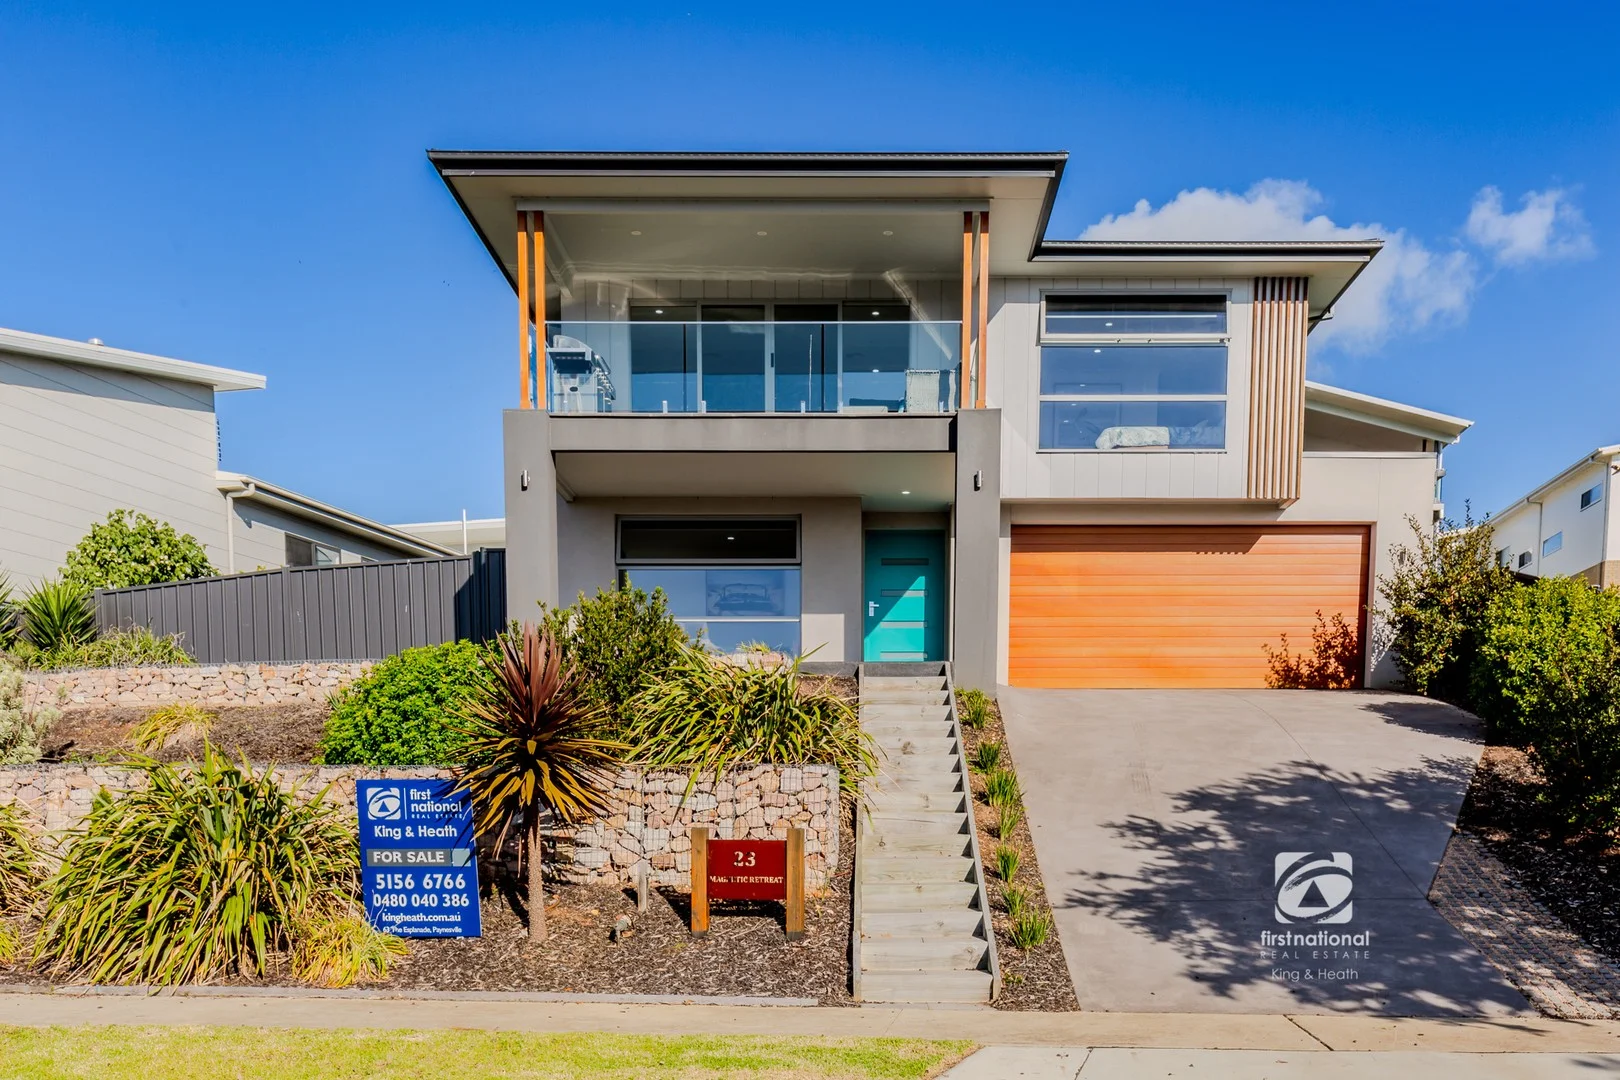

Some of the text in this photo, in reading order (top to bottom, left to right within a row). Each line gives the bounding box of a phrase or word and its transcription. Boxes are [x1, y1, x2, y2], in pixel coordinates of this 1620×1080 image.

[410, 788, 431, 801] first
[411, 801, 462, 813] national
[374, 825, 457, 839] King & Heath
[373, 851, 445, 863] FOR SALE
[733, 851, 756, 867] 23
[376, 873, 466, 890] 5156 6766
[749, 875, 784, 884] RETREAT
[373, 893, 470, 907] 0480 040 386
[382, 911, 461, 923] kingheath.com.au
